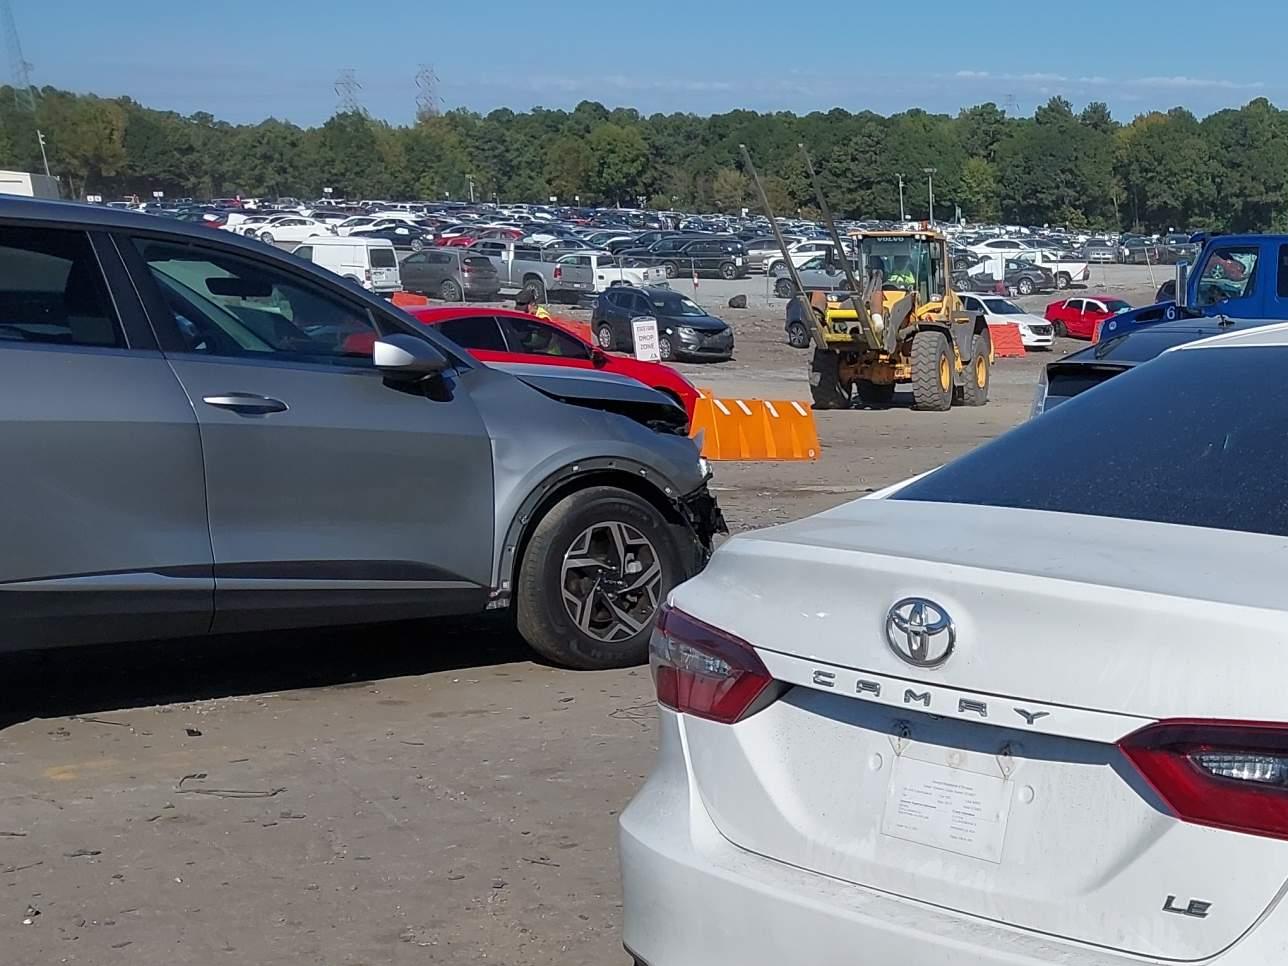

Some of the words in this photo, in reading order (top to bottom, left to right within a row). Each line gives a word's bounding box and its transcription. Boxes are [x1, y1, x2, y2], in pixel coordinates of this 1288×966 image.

[1166, 306, 1176, 320] 6
[812, 670, 1050, 726] CAMRY
[1161, 895, 1212, 919] LE
